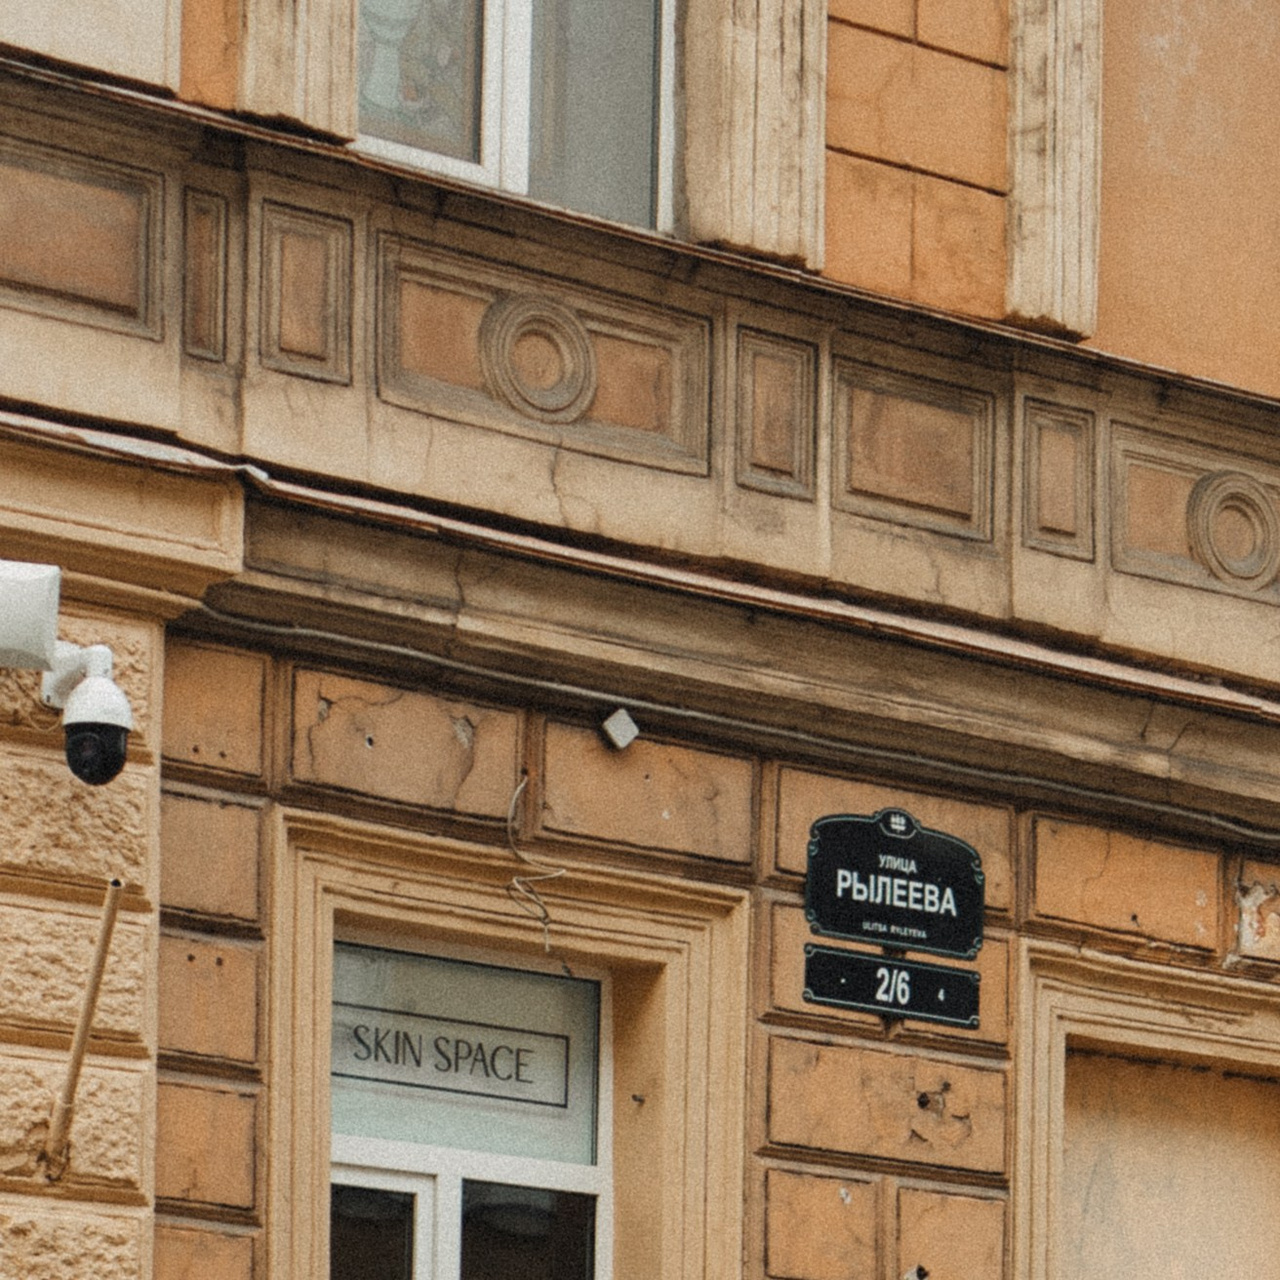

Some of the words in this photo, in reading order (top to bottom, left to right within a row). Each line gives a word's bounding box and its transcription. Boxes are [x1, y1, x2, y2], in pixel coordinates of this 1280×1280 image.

[879, 854, 918, 874] УЛИЦА
[836, 868, 957, 917] РЫЛЕЕВА
[876, 967, 910, 1005] 2/6
[353, 1024, 423, 1068] SKIN
[433, 1036, 534, 1084] SPACE
